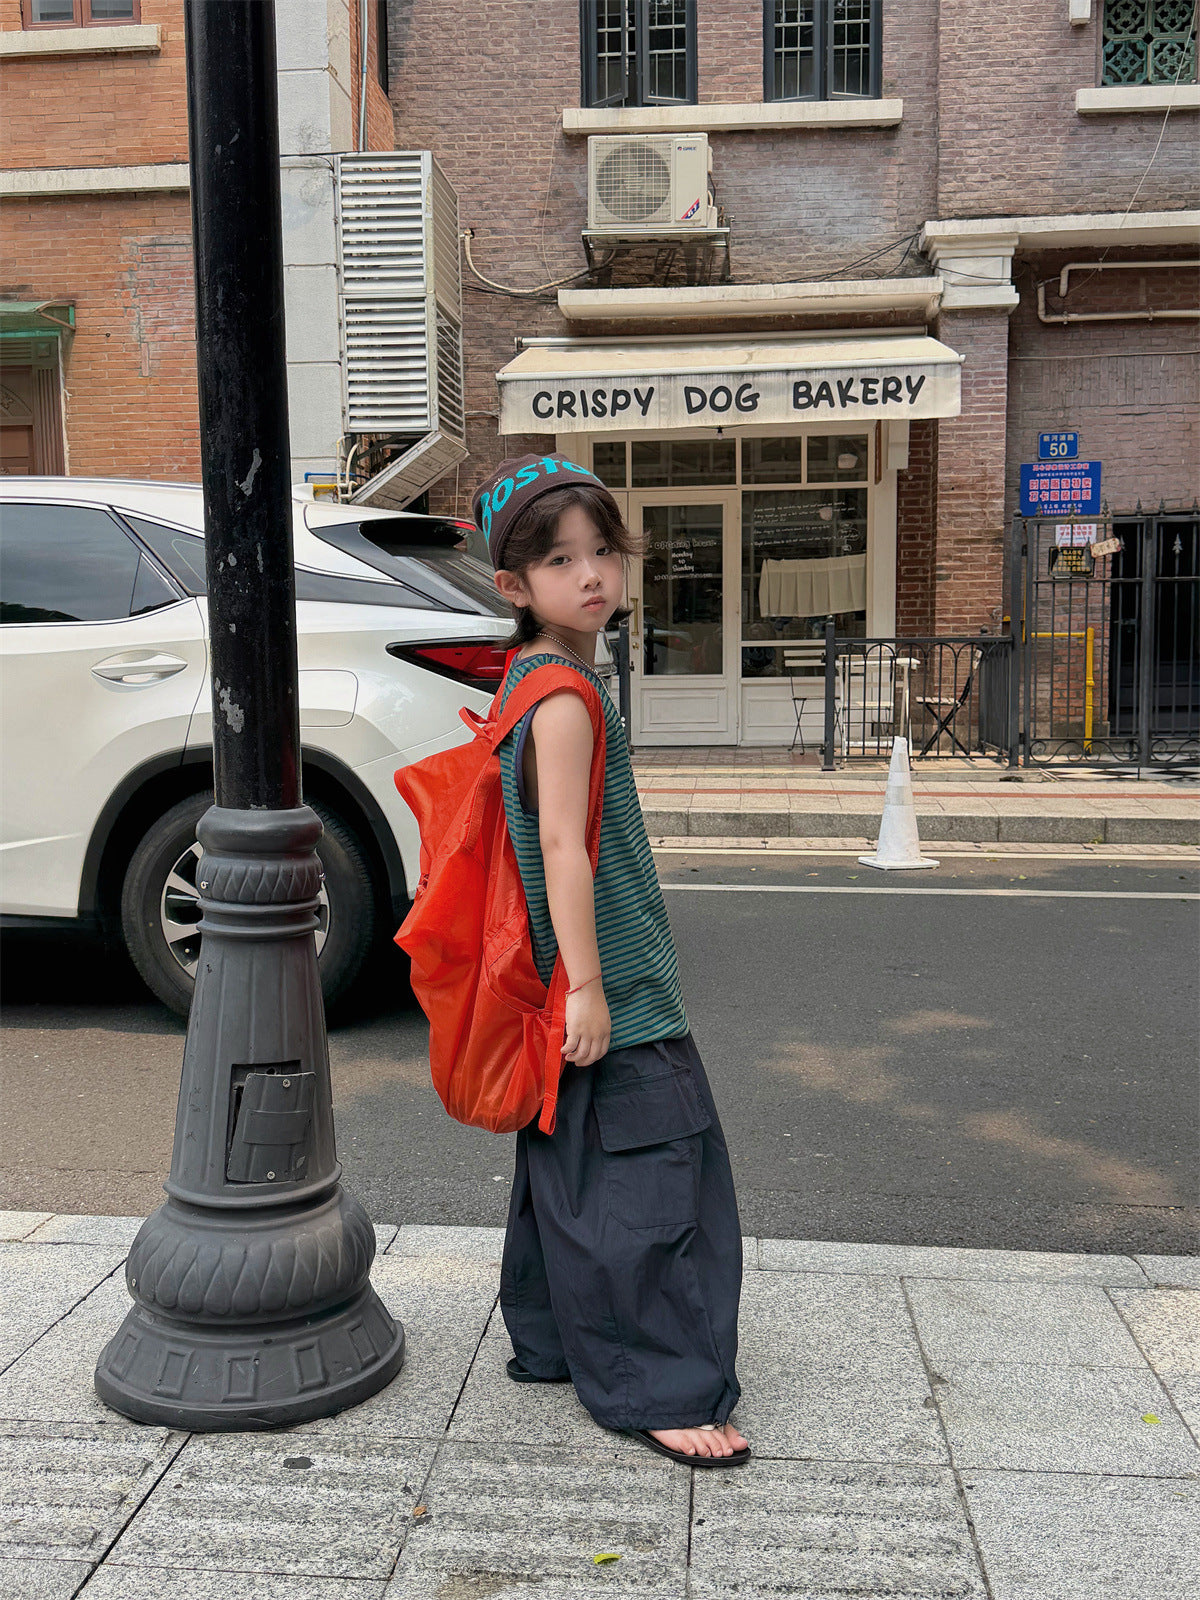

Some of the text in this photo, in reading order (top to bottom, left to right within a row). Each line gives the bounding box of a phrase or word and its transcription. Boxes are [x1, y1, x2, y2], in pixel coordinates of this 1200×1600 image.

[532, 375, 926, 419] CRISPY DOG BAKERY
[1049, 442, 1068, 457] 50
[480, 457, 606, 549] Bosto
[672, 564, 695, 572] Sunday
